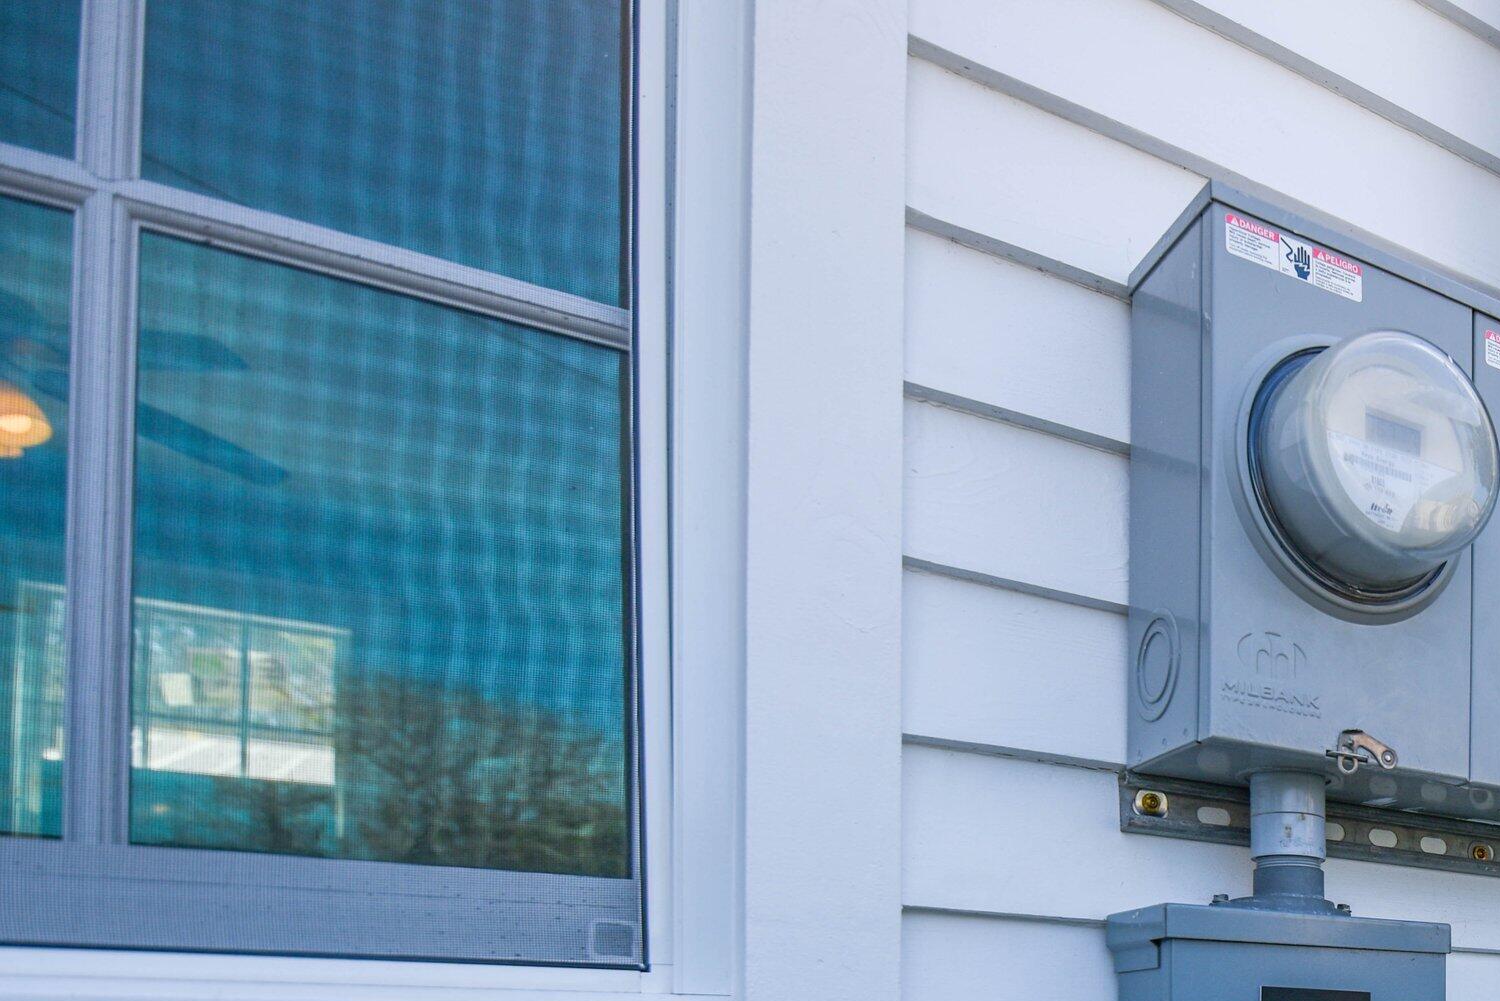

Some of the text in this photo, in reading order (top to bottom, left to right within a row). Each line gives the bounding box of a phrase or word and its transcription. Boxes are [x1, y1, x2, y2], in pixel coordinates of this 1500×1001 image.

[1240, 219, 1275, 241] DANGER
[1325, 253, 1358, 273] PELIGRO
[1221, 681, 1320, 710] MILBANK
